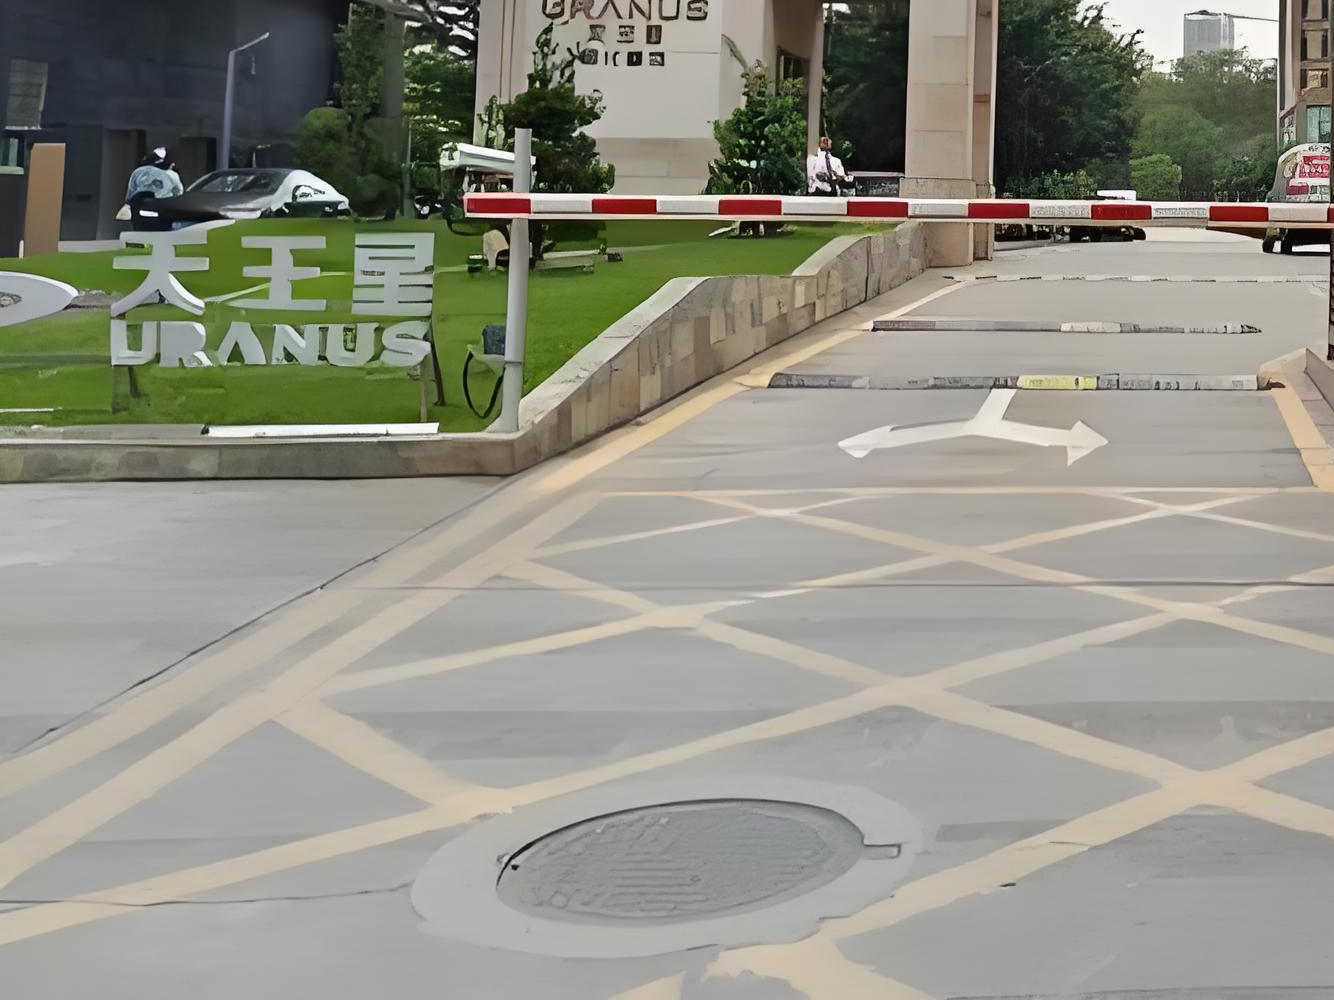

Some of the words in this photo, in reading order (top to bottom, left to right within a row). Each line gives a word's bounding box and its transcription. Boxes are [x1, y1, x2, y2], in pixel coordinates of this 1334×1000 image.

[111, 231, 435, 318] 天王星
[111, 320, 432, 368] URANUS
